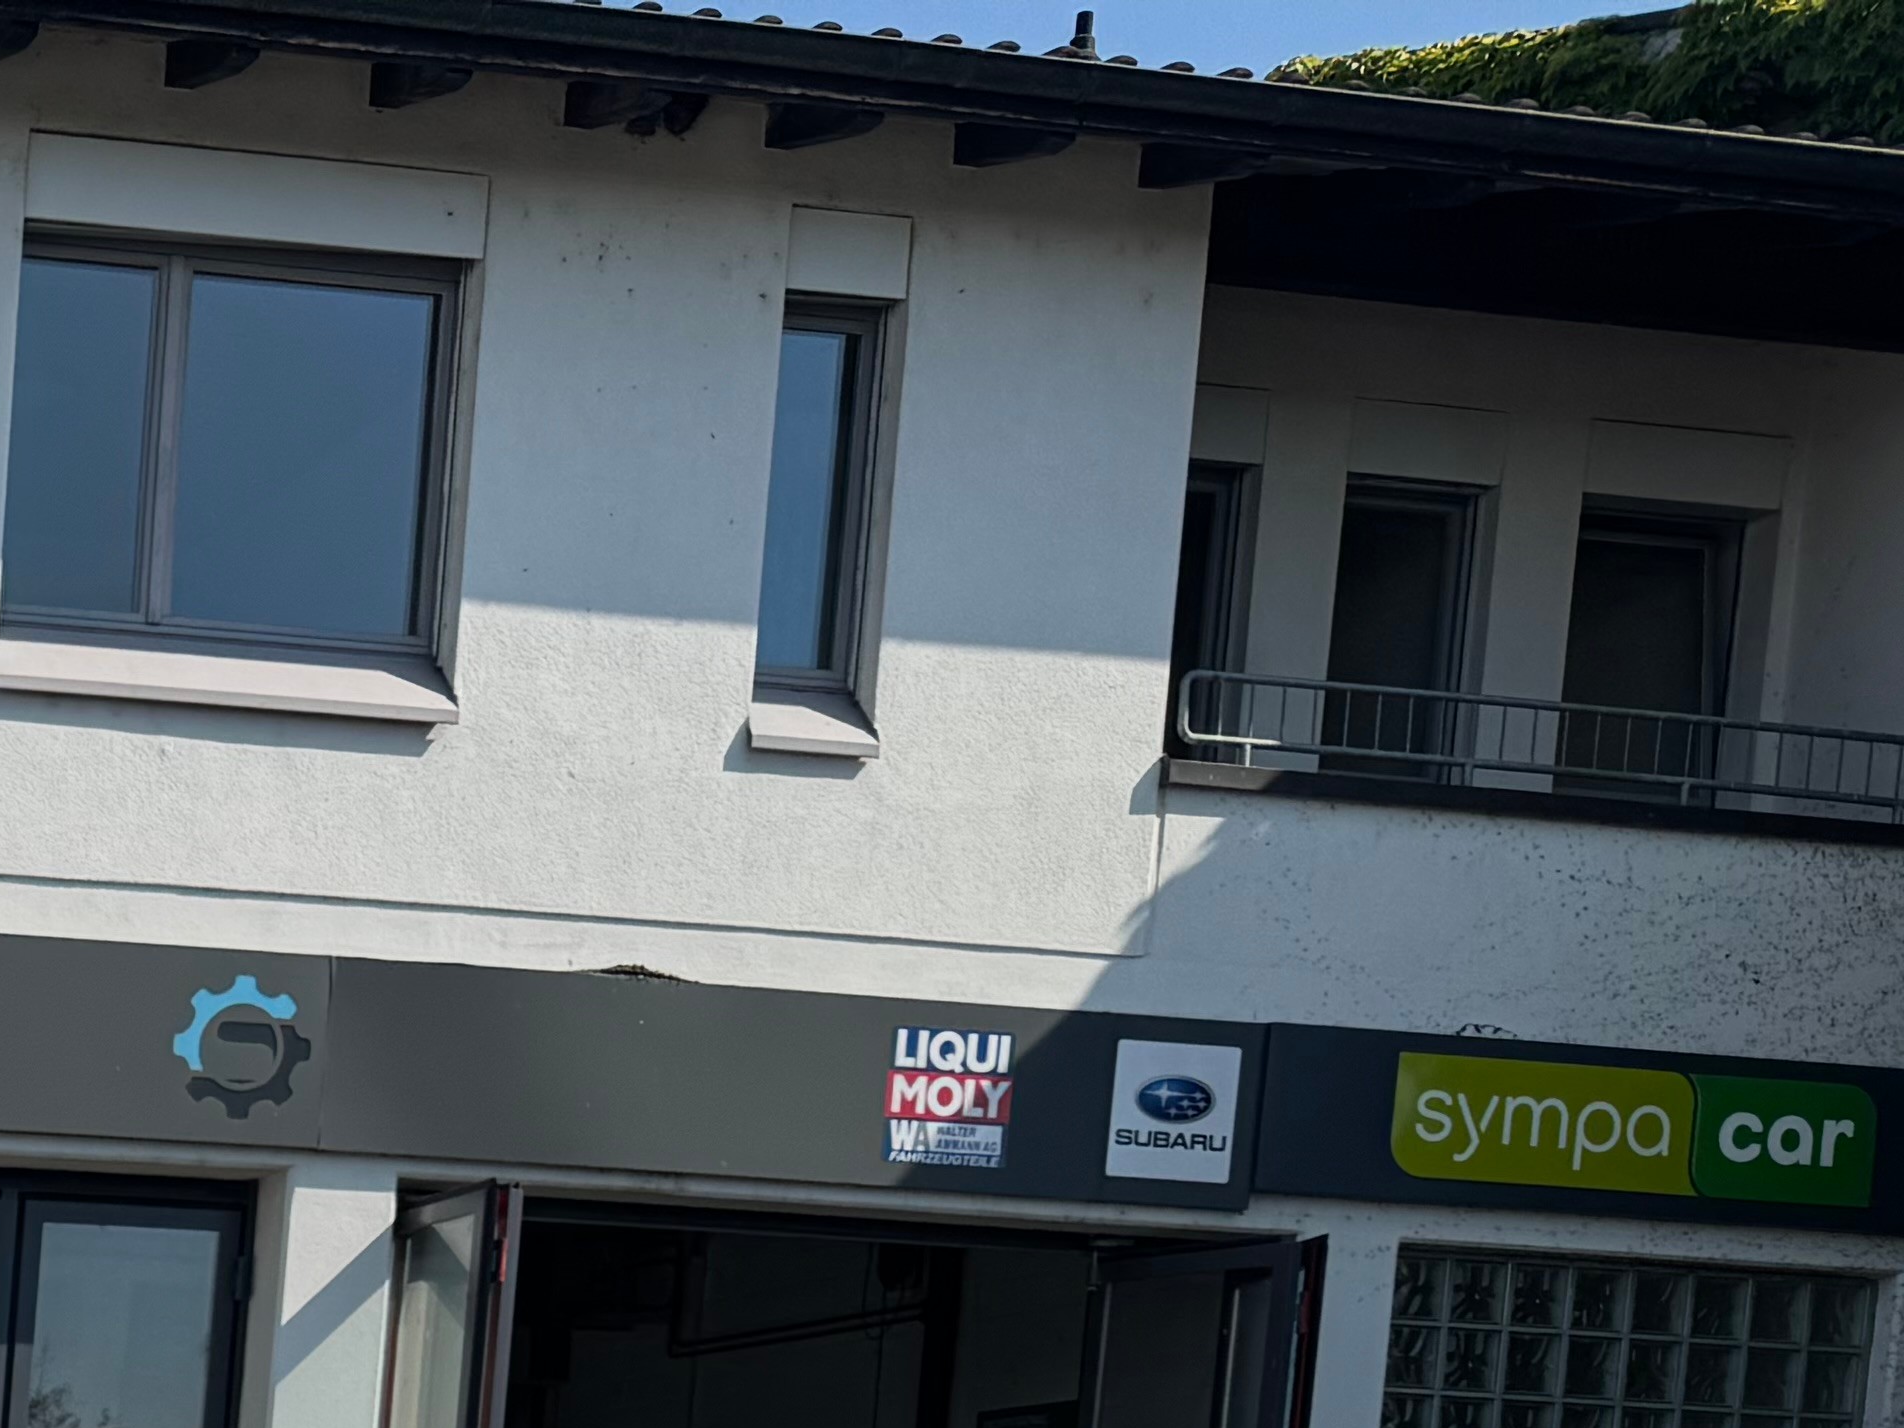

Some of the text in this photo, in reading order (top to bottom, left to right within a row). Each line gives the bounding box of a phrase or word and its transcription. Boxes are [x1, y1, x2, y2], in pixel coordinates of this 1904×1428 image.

[894, 1027, 1012, 1075] LIQUI
[890, 1074, 1012, 1118] MOLY
[1114, 1128, 1227, 1153] SUBARU
[1414, 1089, 1856, 1172] sympa car
[888, 1150, 1000, 1168] FAHRZEUGTEILE
